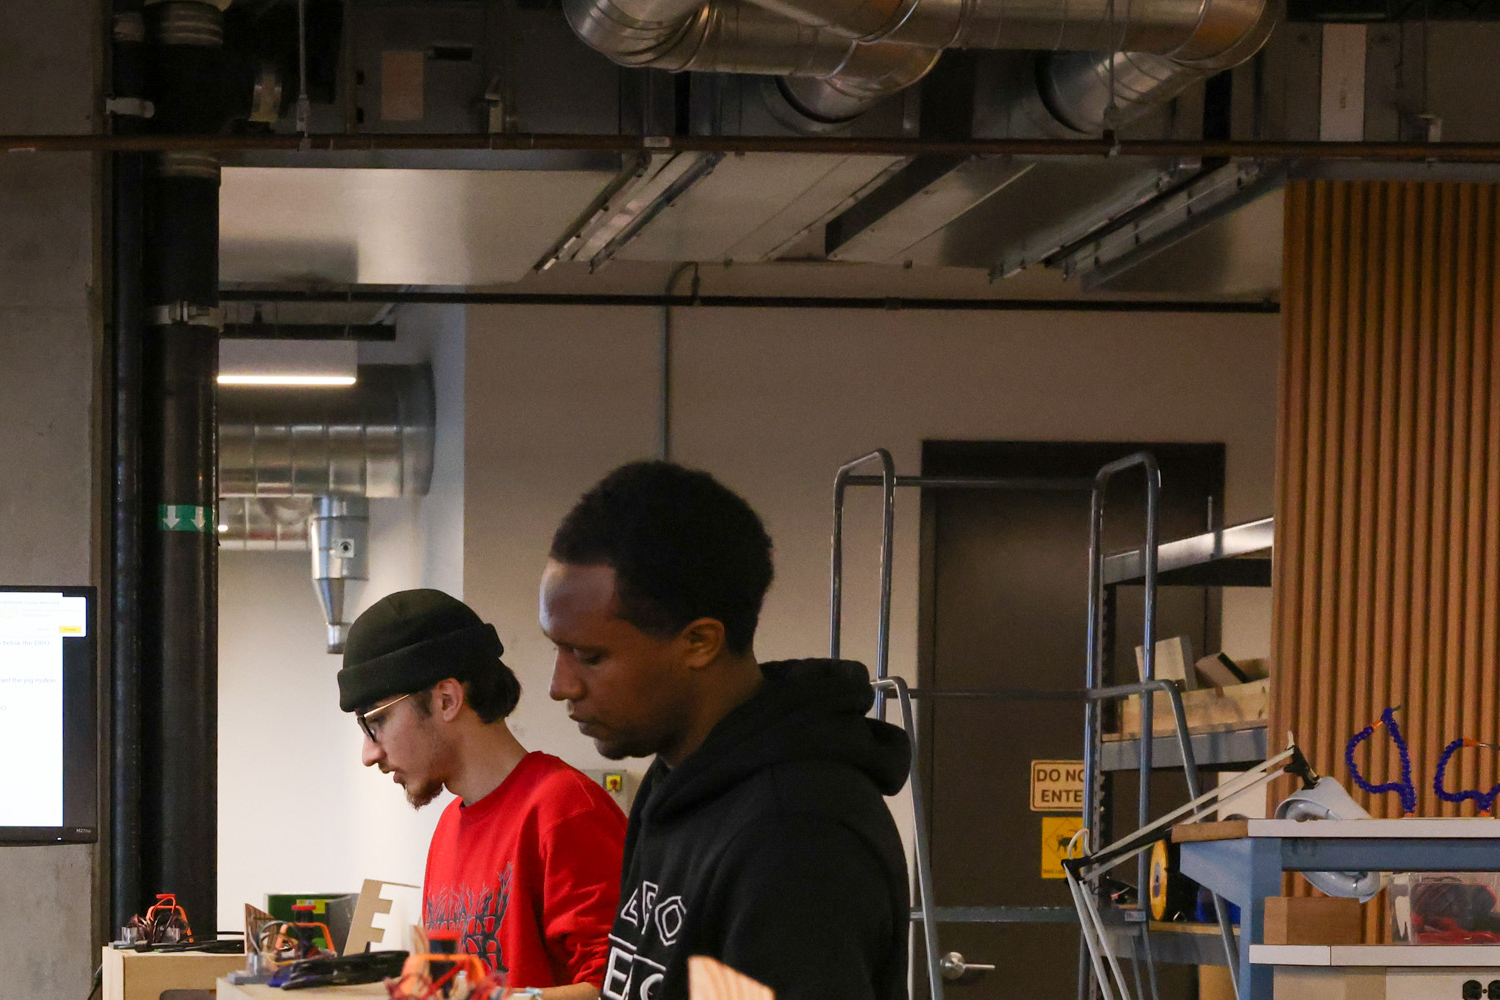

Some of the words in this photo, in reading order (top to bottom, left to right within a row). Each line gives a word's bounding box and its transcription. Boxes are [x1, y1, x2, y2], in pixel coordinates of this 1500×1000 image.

[1037, 769, 1060, 782] DO
[1066, 769, 1084, 782] NO
[1041, 789, 1083, 802] ENTE
